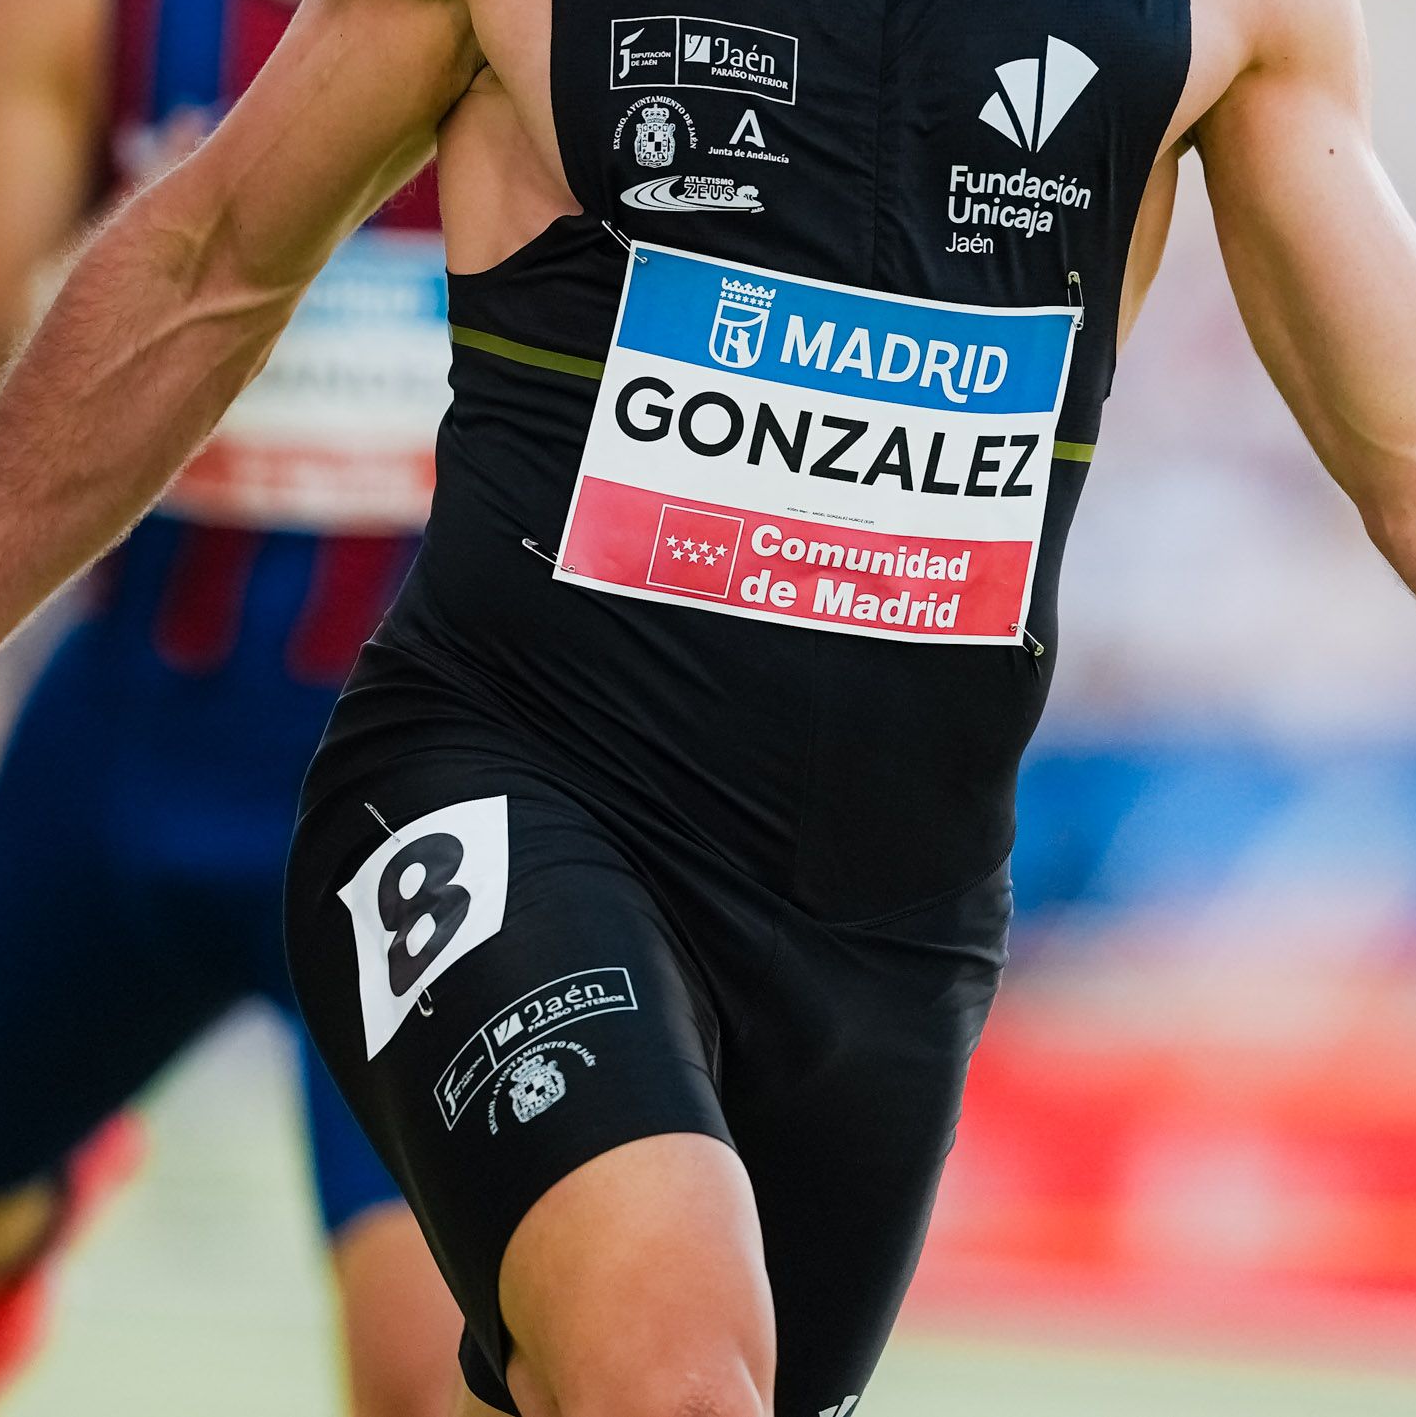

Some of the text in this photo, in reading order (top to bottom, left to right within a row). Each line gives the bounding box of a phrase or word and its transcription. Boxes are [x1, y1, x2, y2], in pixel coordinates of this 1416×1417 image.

[631, 51, 671, 59] DIPUTACIÓN
[640, 58, 658, 66] JAÉN
[714, 37, 775, 75] Jaén
[711, 66, 789, 90] PARAÍSO INTERIOR
[613, 95, 699, 150] EXCMO. AYUNTAMIENTO DE JAÉN
[708, 146, 790, 164] Junta de Andalucía
[684, 176, 735, 186] ATLETISMO
[684, 184, 735, 202] ZEUS
[949, 164, 1092, 210] Fundación
[948, 195, 1054, 239] Unicaja
[945, 232, 994, 254] Jaén
[780, 314, 1009, 405] MADRID
[614, 375, 1041, 498] GONZALEZ
[750, 524, 971, 583] Comunidad
[739, 568, 959, 630] de Madrid
[378, 832, 471, 998] 8
[524, 984, 605, 1024] Jaén
[574, 995, 626, 1011] INTERIOR
